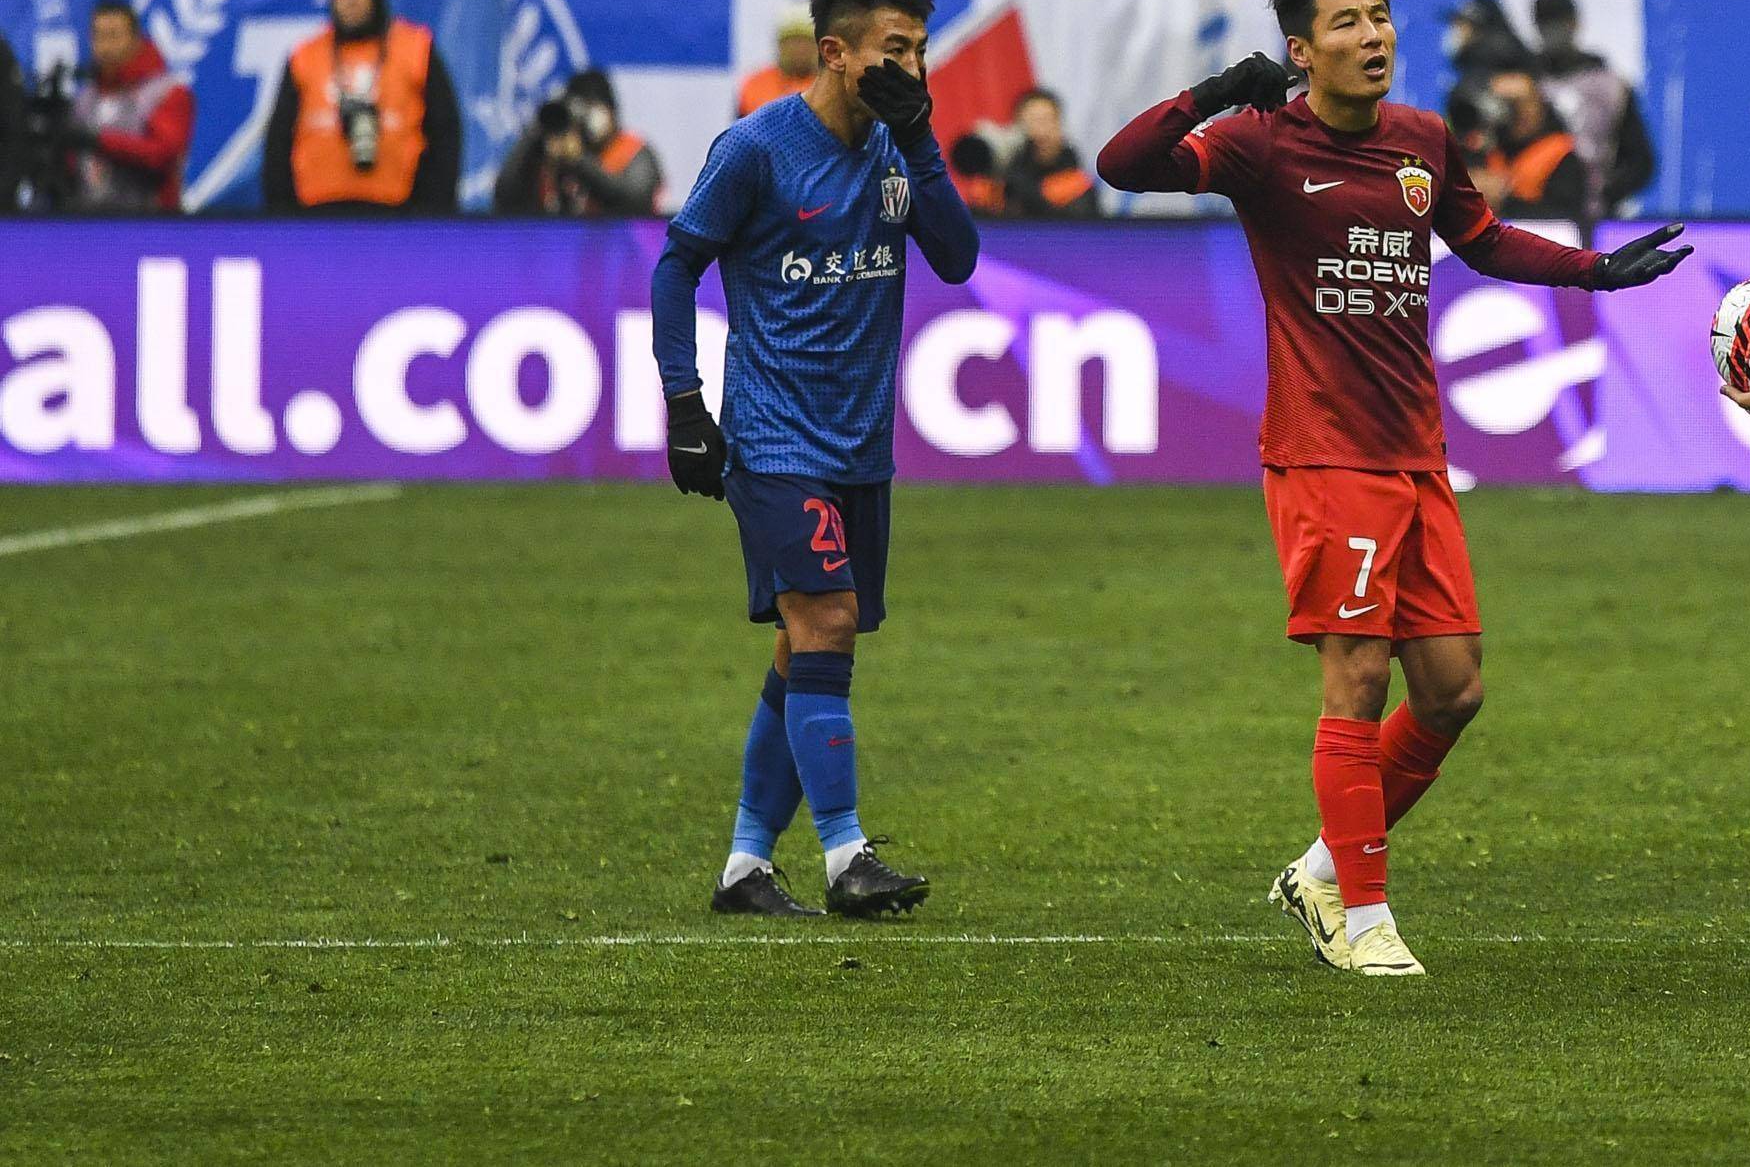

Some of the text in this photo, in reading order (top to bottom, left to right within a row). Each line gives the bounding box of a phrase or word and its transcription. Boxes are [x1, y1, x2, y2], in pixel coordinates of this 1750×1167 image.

[1348, 226, 1413, 258] 荣威
[812, 275, 841, 285] BANK
[1317, 258, 1430, 286] ROEWE
[1348, 537, 1377, 598] 7
